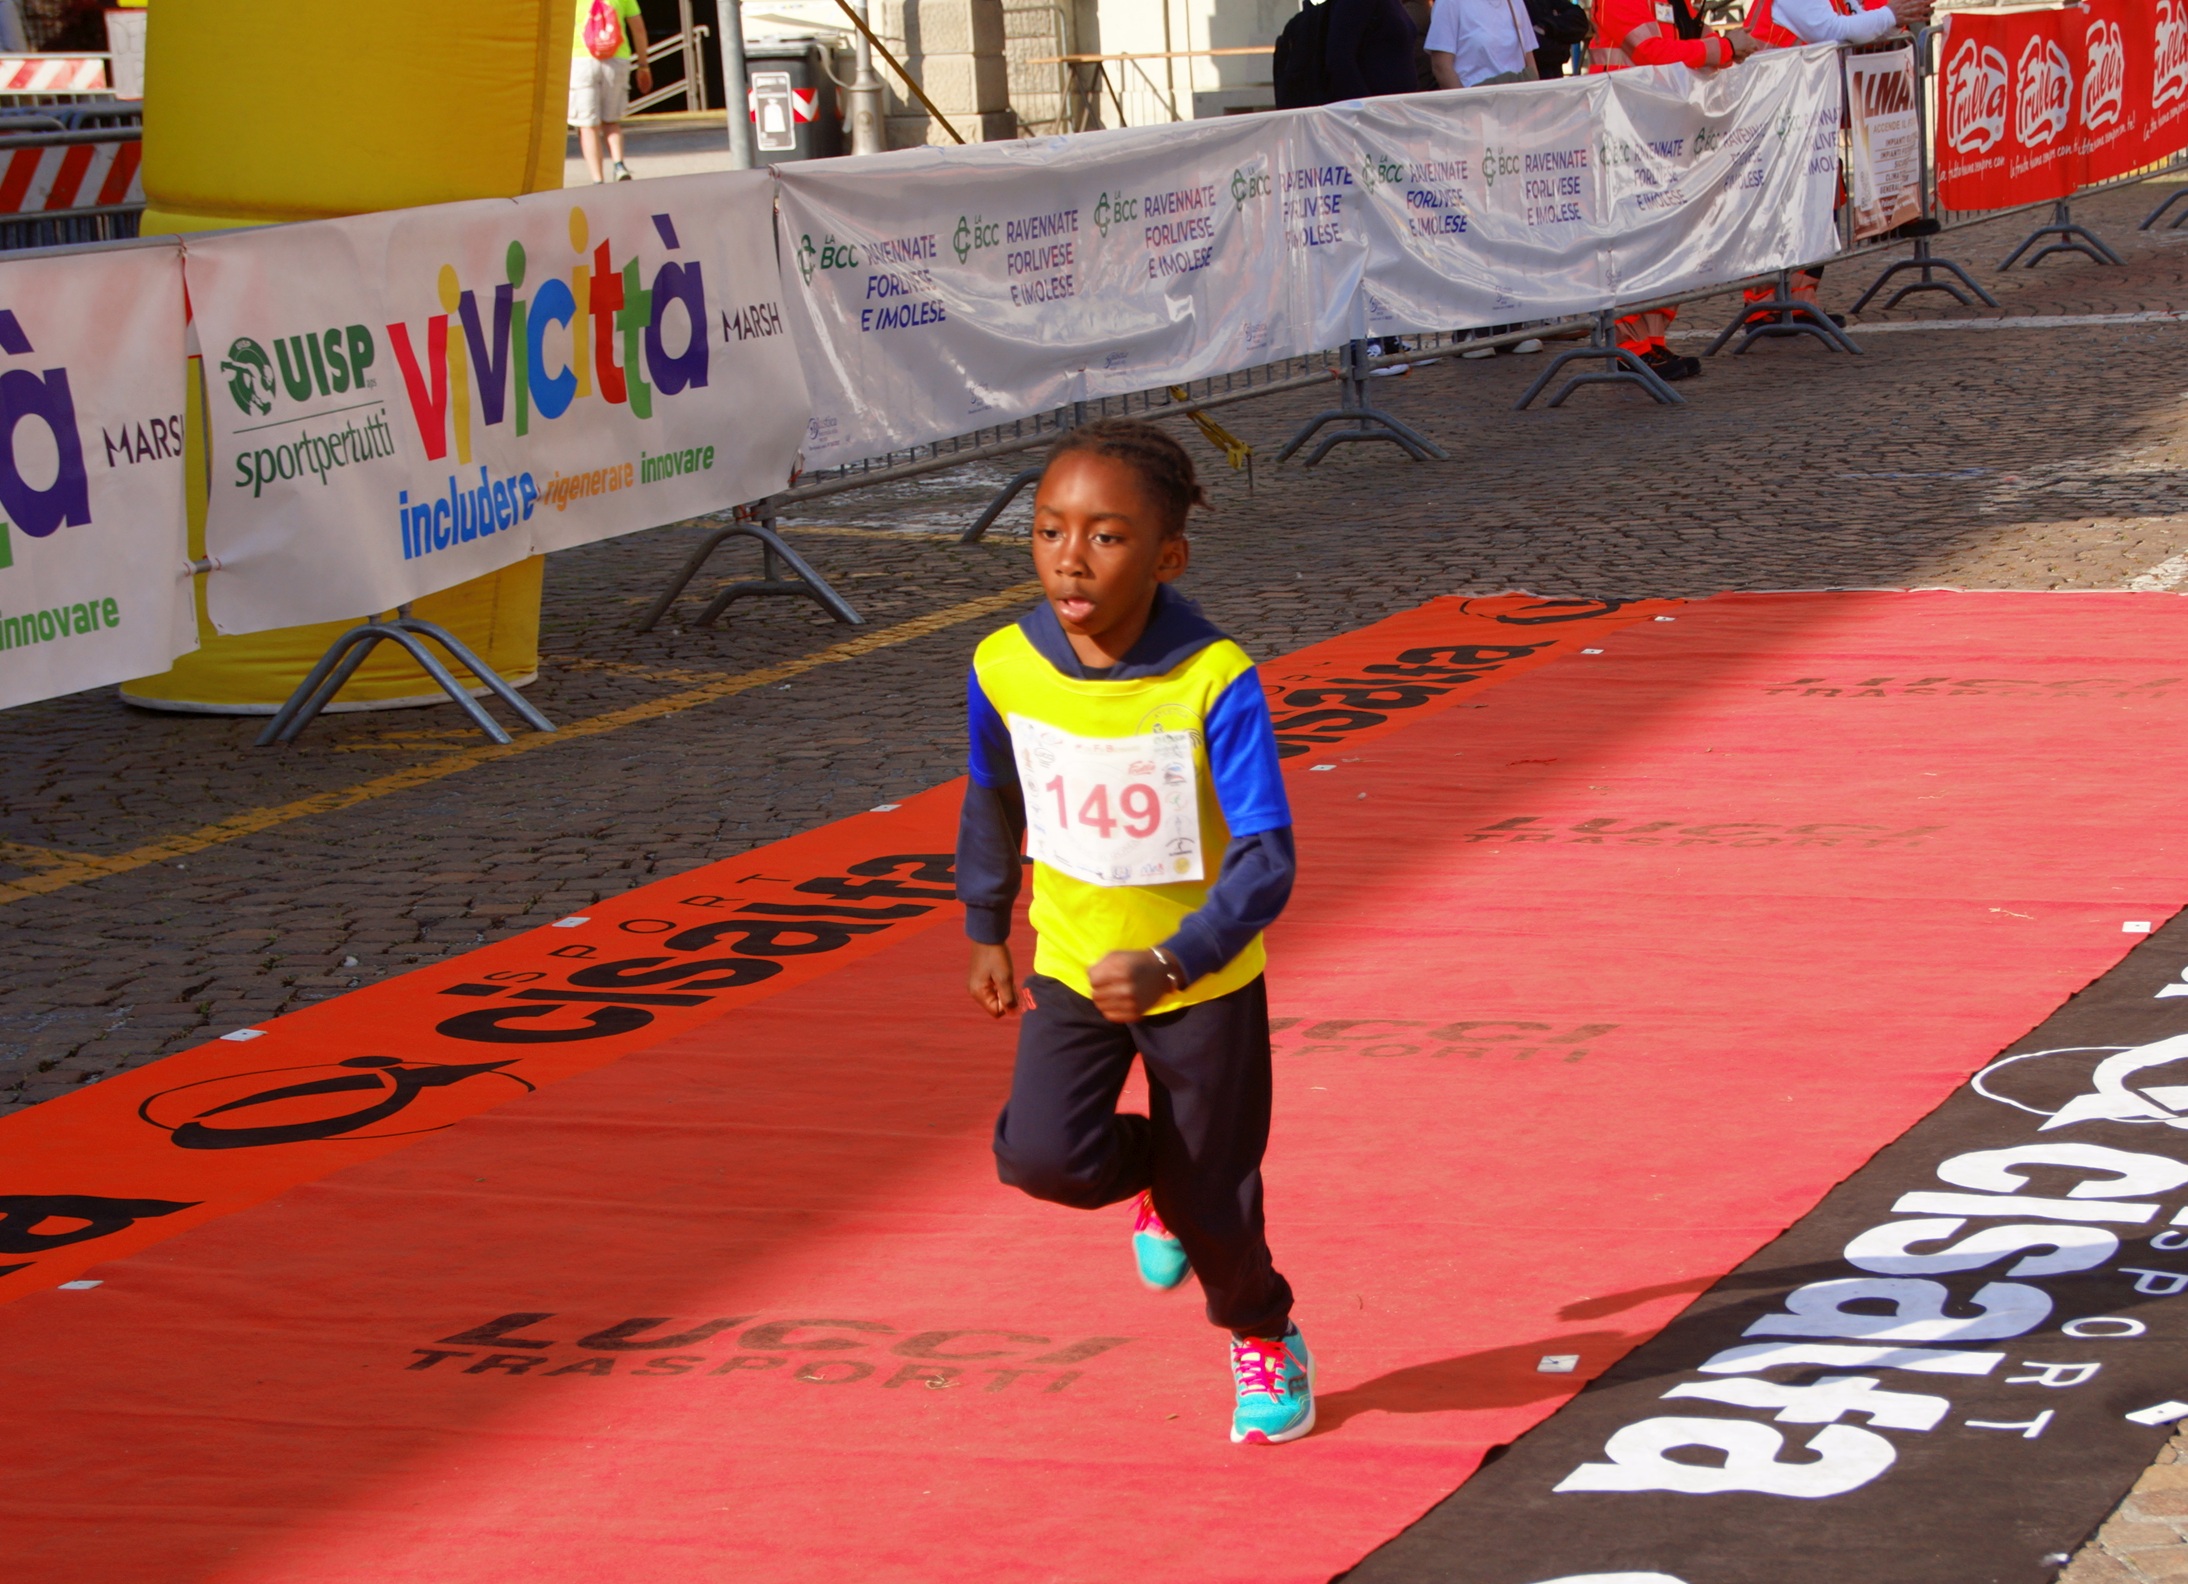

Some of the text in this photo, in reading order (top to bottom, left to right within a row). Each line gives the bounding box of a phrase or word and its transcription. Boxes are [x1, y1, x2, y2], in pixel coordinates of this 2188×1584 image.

[1378, 164, 1404, 183] BCC
[1498, 155, 1520, 175] BCC
[1525, 149, 1587, 173] RAVENNATE
[1144, 185, 1216, 218] RAVENNATE
[1249, 175, 1272, 198] BCC
[1525, 176, 1581, 199] FORLIVESE
[1006, 209, 1079, 243] RAVENNATE
[1113, 198, 1138, 223] BCC
[1409, 214, 1468, 237] E IMOLESE
[1527, 202, 1582, 226] E IMOLESE
[974, 223, 1000, 249] BCC
[1145, 216, 1214, 248] FORLIVESE
[820, 244, 859, 269] BCC
[1007, 242, 1074, 276] FORLIVESE
[1148, 246, 1213, 279] E IMOLESE
[1010, 274, 1075, 307] E IMOLESE
[721, 302, 783, 343] MARSH
[861, 299, 947, 332] E IMOLESE
[386, 206, 709, 465] vivicittà
[273, 324, 375, 402] UISP
[103, 414, 185, 468] MARS
[235, 408, 395, 498] sportpertutti
[399, 445, 714, 560] includere rigenerare innovare
[1045, 774, 1161, 839] 149
[1552, 1143, 2188, 1497] cisalfa
[433, 1312, 1139, 1364] LUCCI
[403, 1349, 1085, 1394] TRASPORTI
